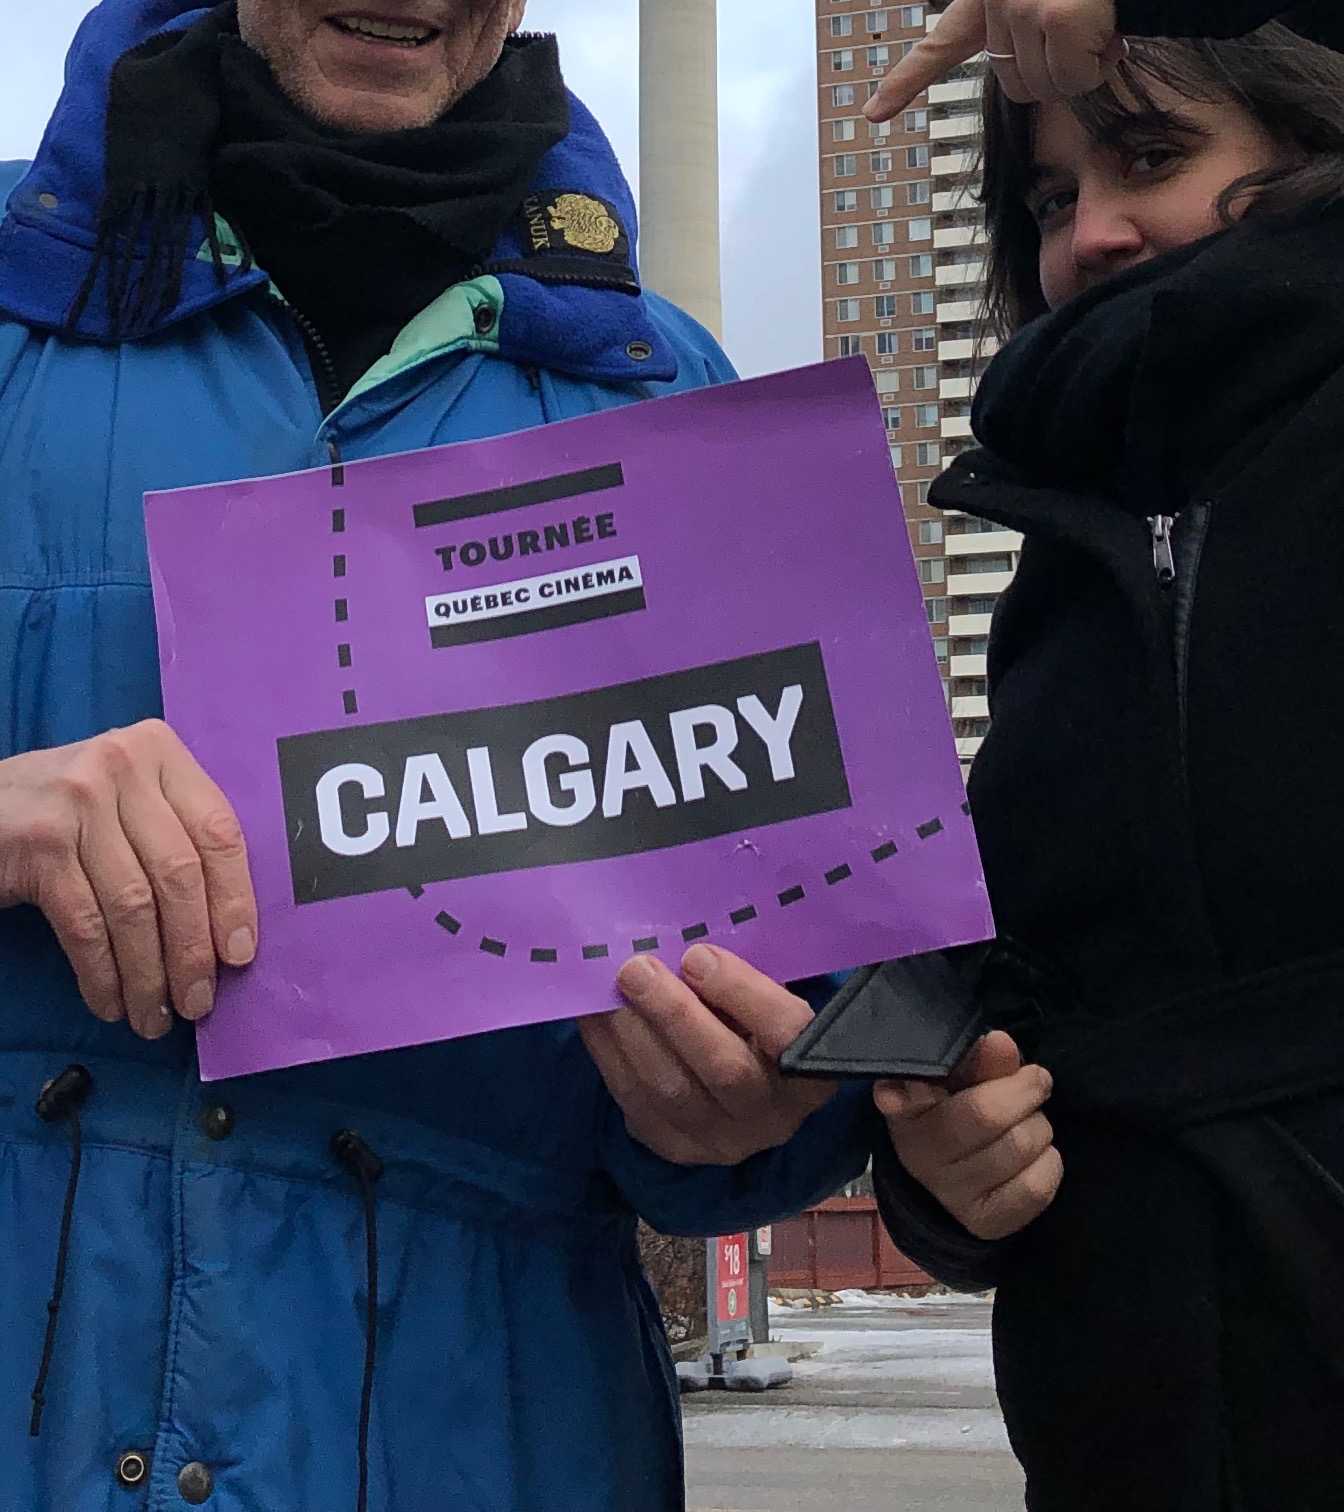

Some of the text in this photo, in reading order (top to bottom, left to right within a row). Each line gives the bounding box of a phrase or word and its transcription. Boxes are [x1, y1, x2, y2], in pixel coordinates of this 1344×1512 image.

[435, 511, 617, 572] TOURNÉE
[433, 563, 635, 621] QUÉBEC CINÉMA
[314, 683, 805, 858] CALGARY
